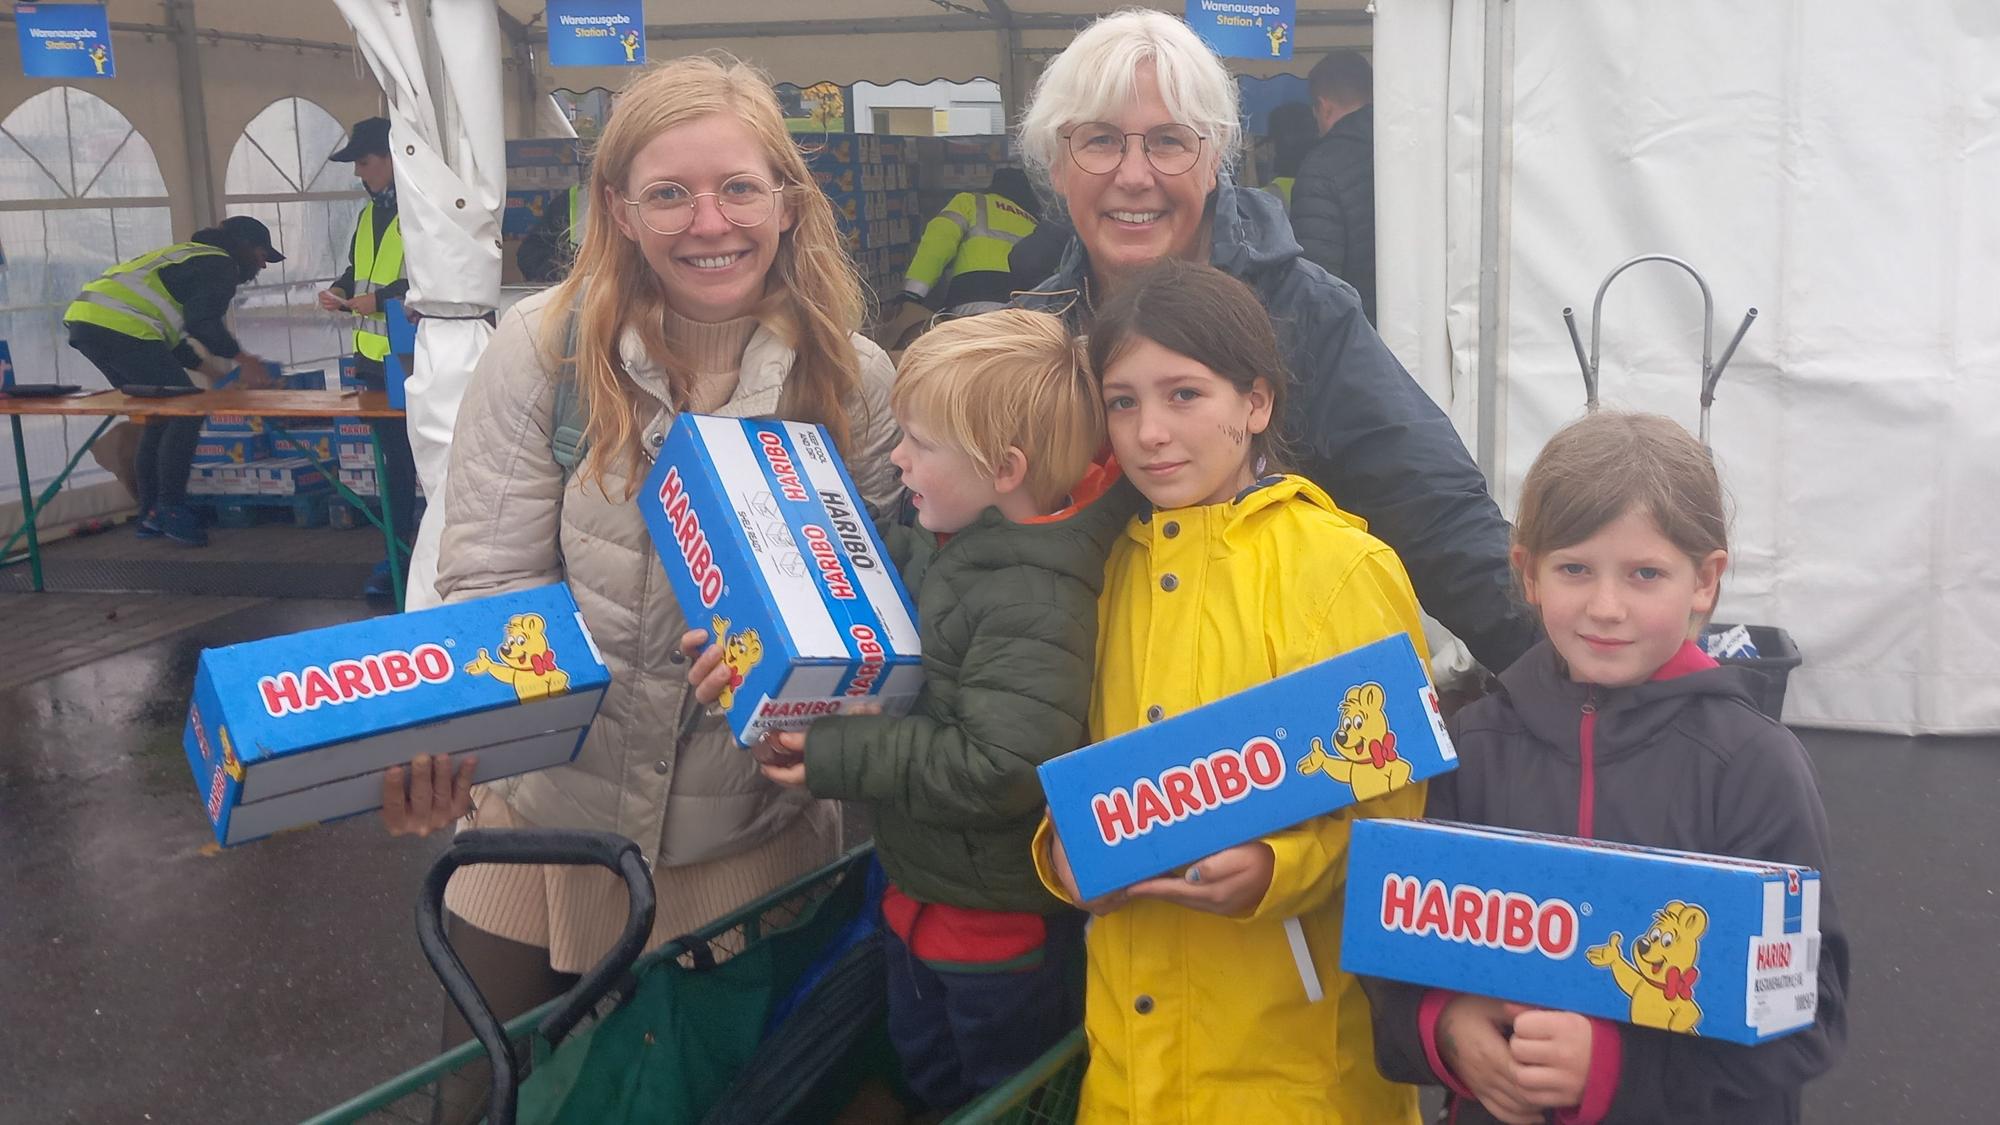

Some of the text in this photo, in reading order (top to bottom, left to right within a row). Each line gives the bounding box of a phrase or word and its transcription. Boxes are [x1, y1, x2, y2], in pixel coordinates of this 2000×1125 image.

[560, 14, 630, 26] Warenausgabe
[1201, 0, 1280, 16] Warenausgabe
[1216, 15, 1263, 28] Station 4
[29, 28, 97, 40] Warenausgabe
[45, 40, 77, 50] Station
[575, 27, 617, 37] Station 3
[757, 431, 809, 502] HARIBO
[660, 467, 724, 607] HARIBO
[818, 490, 876, 570] HARIBO
[802, 525, 857, 600] HARIBO
[259, 644, 453, 717] HARIBO
[760, 701, 841, 717] HARIBO
[1092, 737, 1285, 846] HARIBO
[1380, 873, 1579, 960] HARIBO
[1757, 942, 1792, 971] HARIBO
